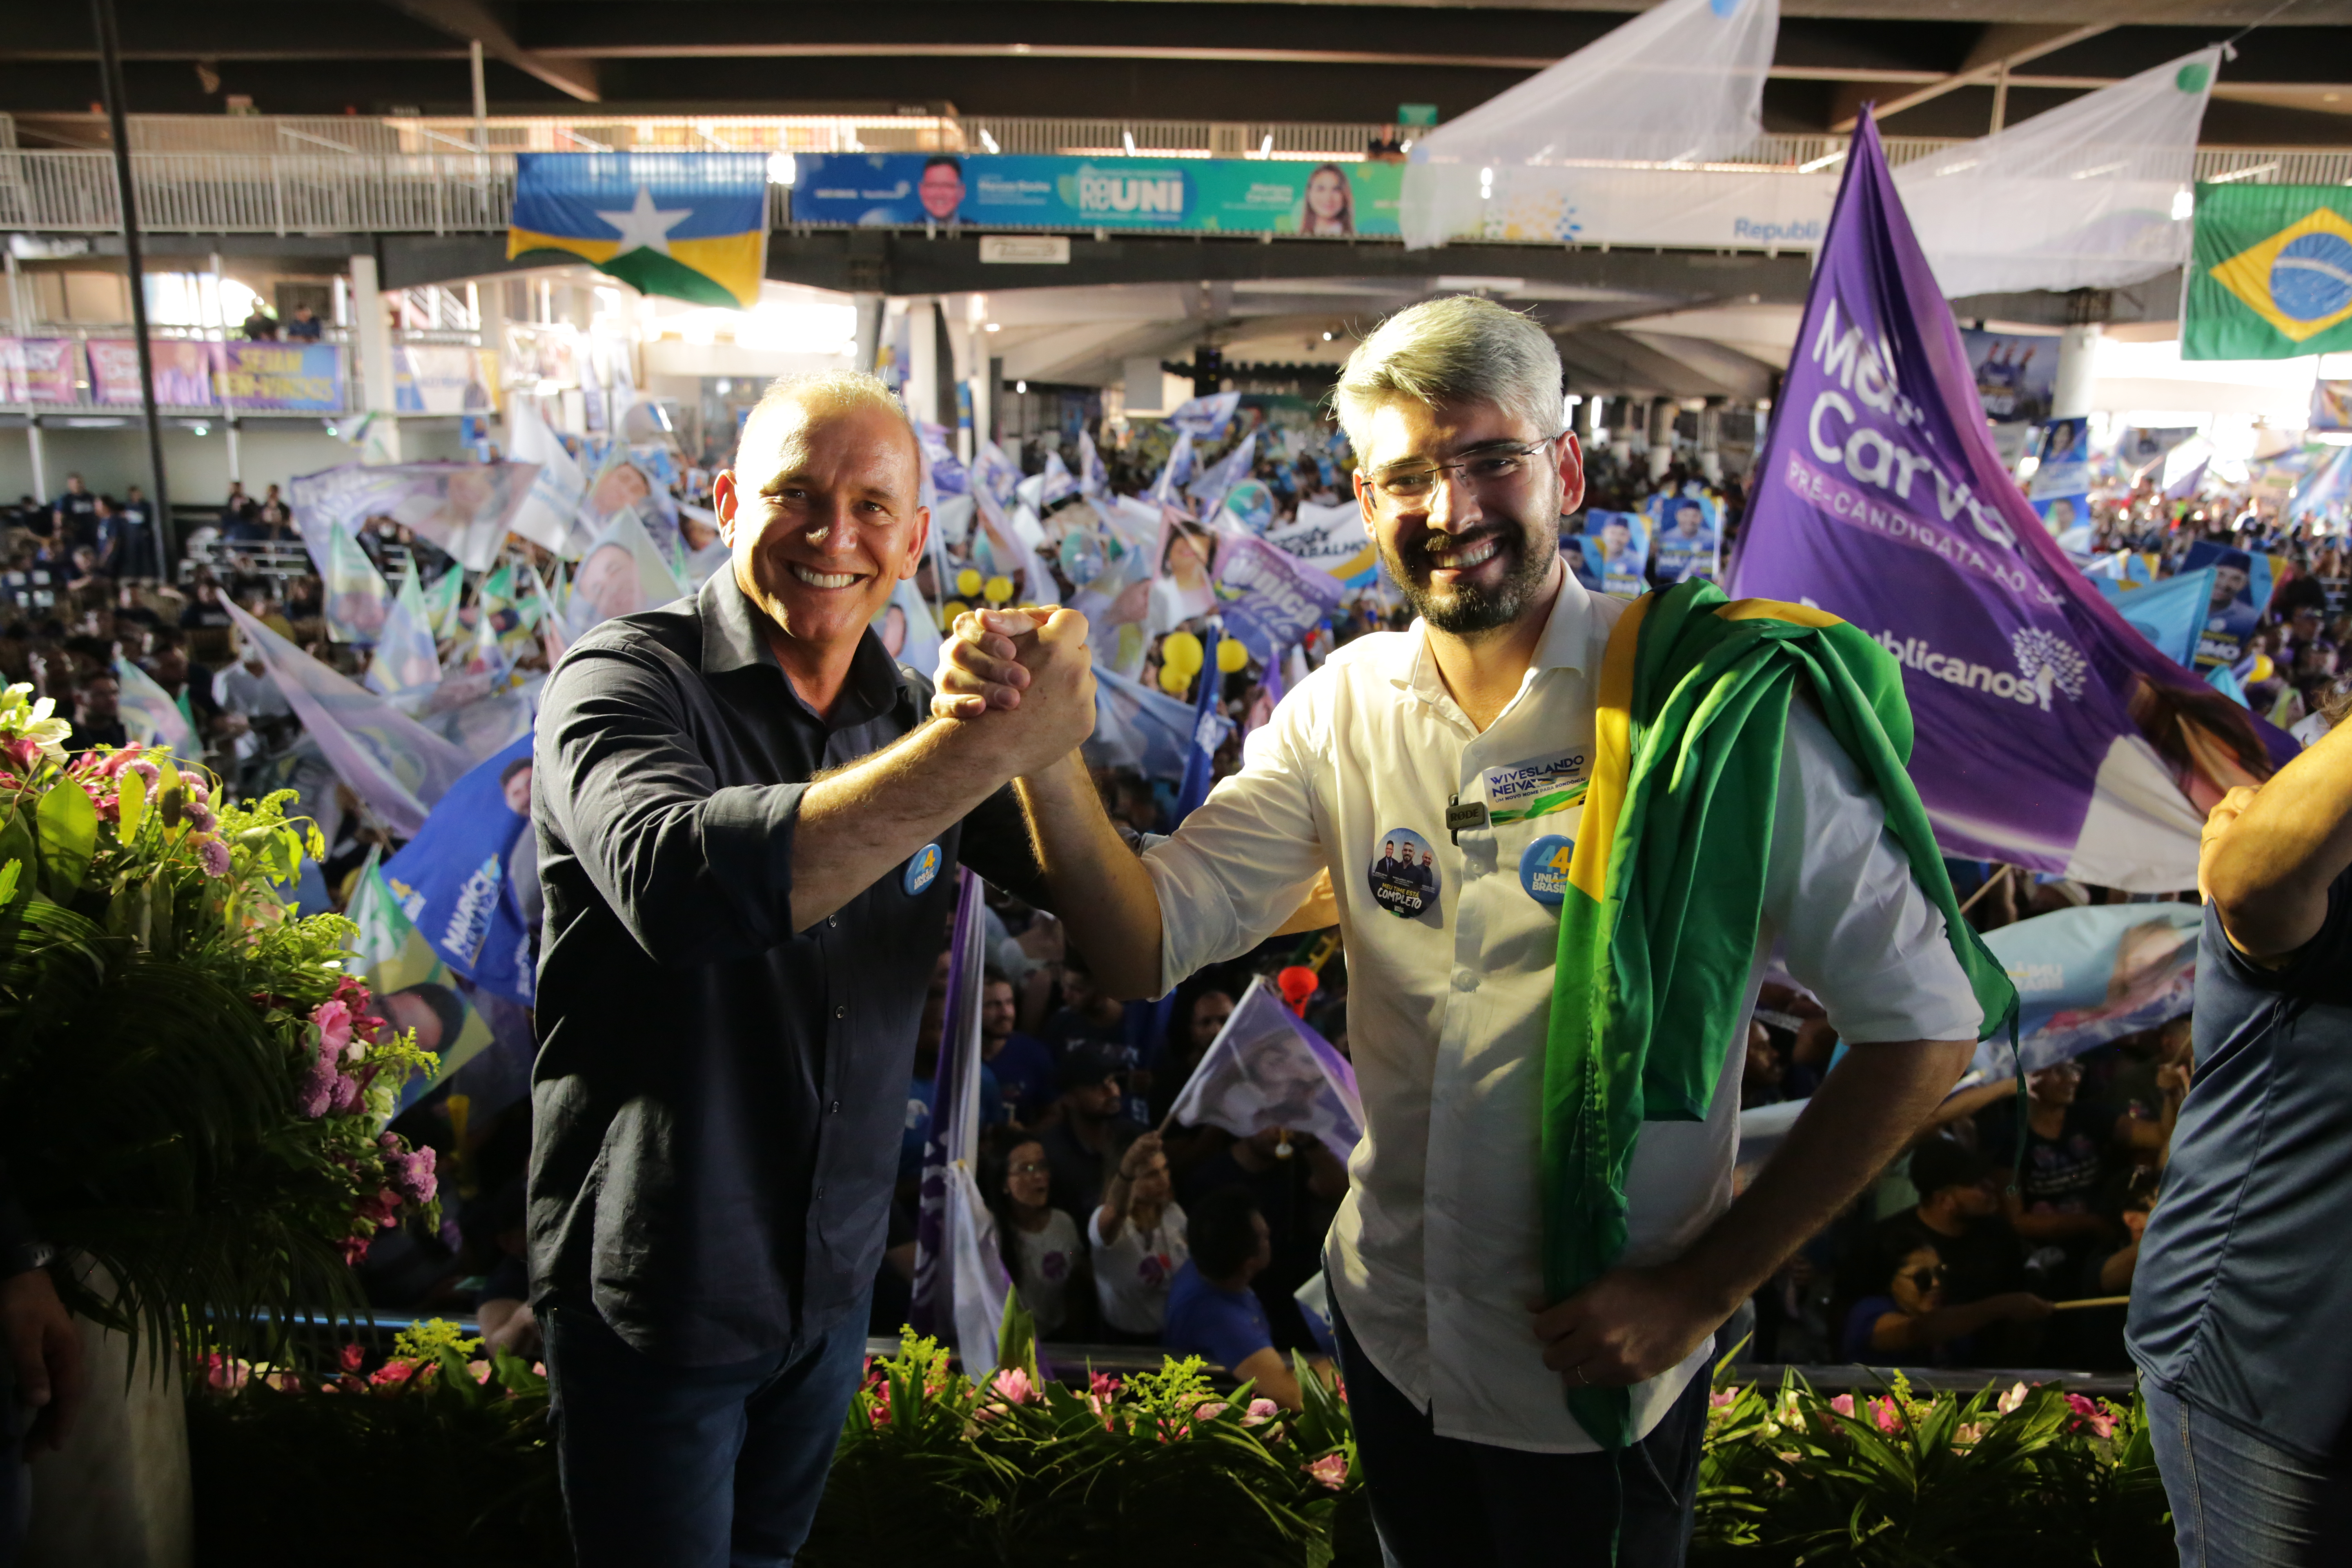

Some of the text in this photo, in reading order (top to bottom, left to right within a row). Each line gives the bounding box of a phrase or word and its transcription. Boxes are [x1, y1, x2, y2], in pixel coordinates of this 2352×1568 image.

[1734, 217, 1820, 243] Republi
[1490, 755, 1584, 784] WIVESLANDO
[1492, 778, 1536, 797] NEIVA
[1555, 777, 1586, 788] RONDÔNIA!
[914, 872, 935, 890] BRASIL
[1394, 886, 1405, 894] TIME
[1377, 887, 1422, 909] COMPLETO
